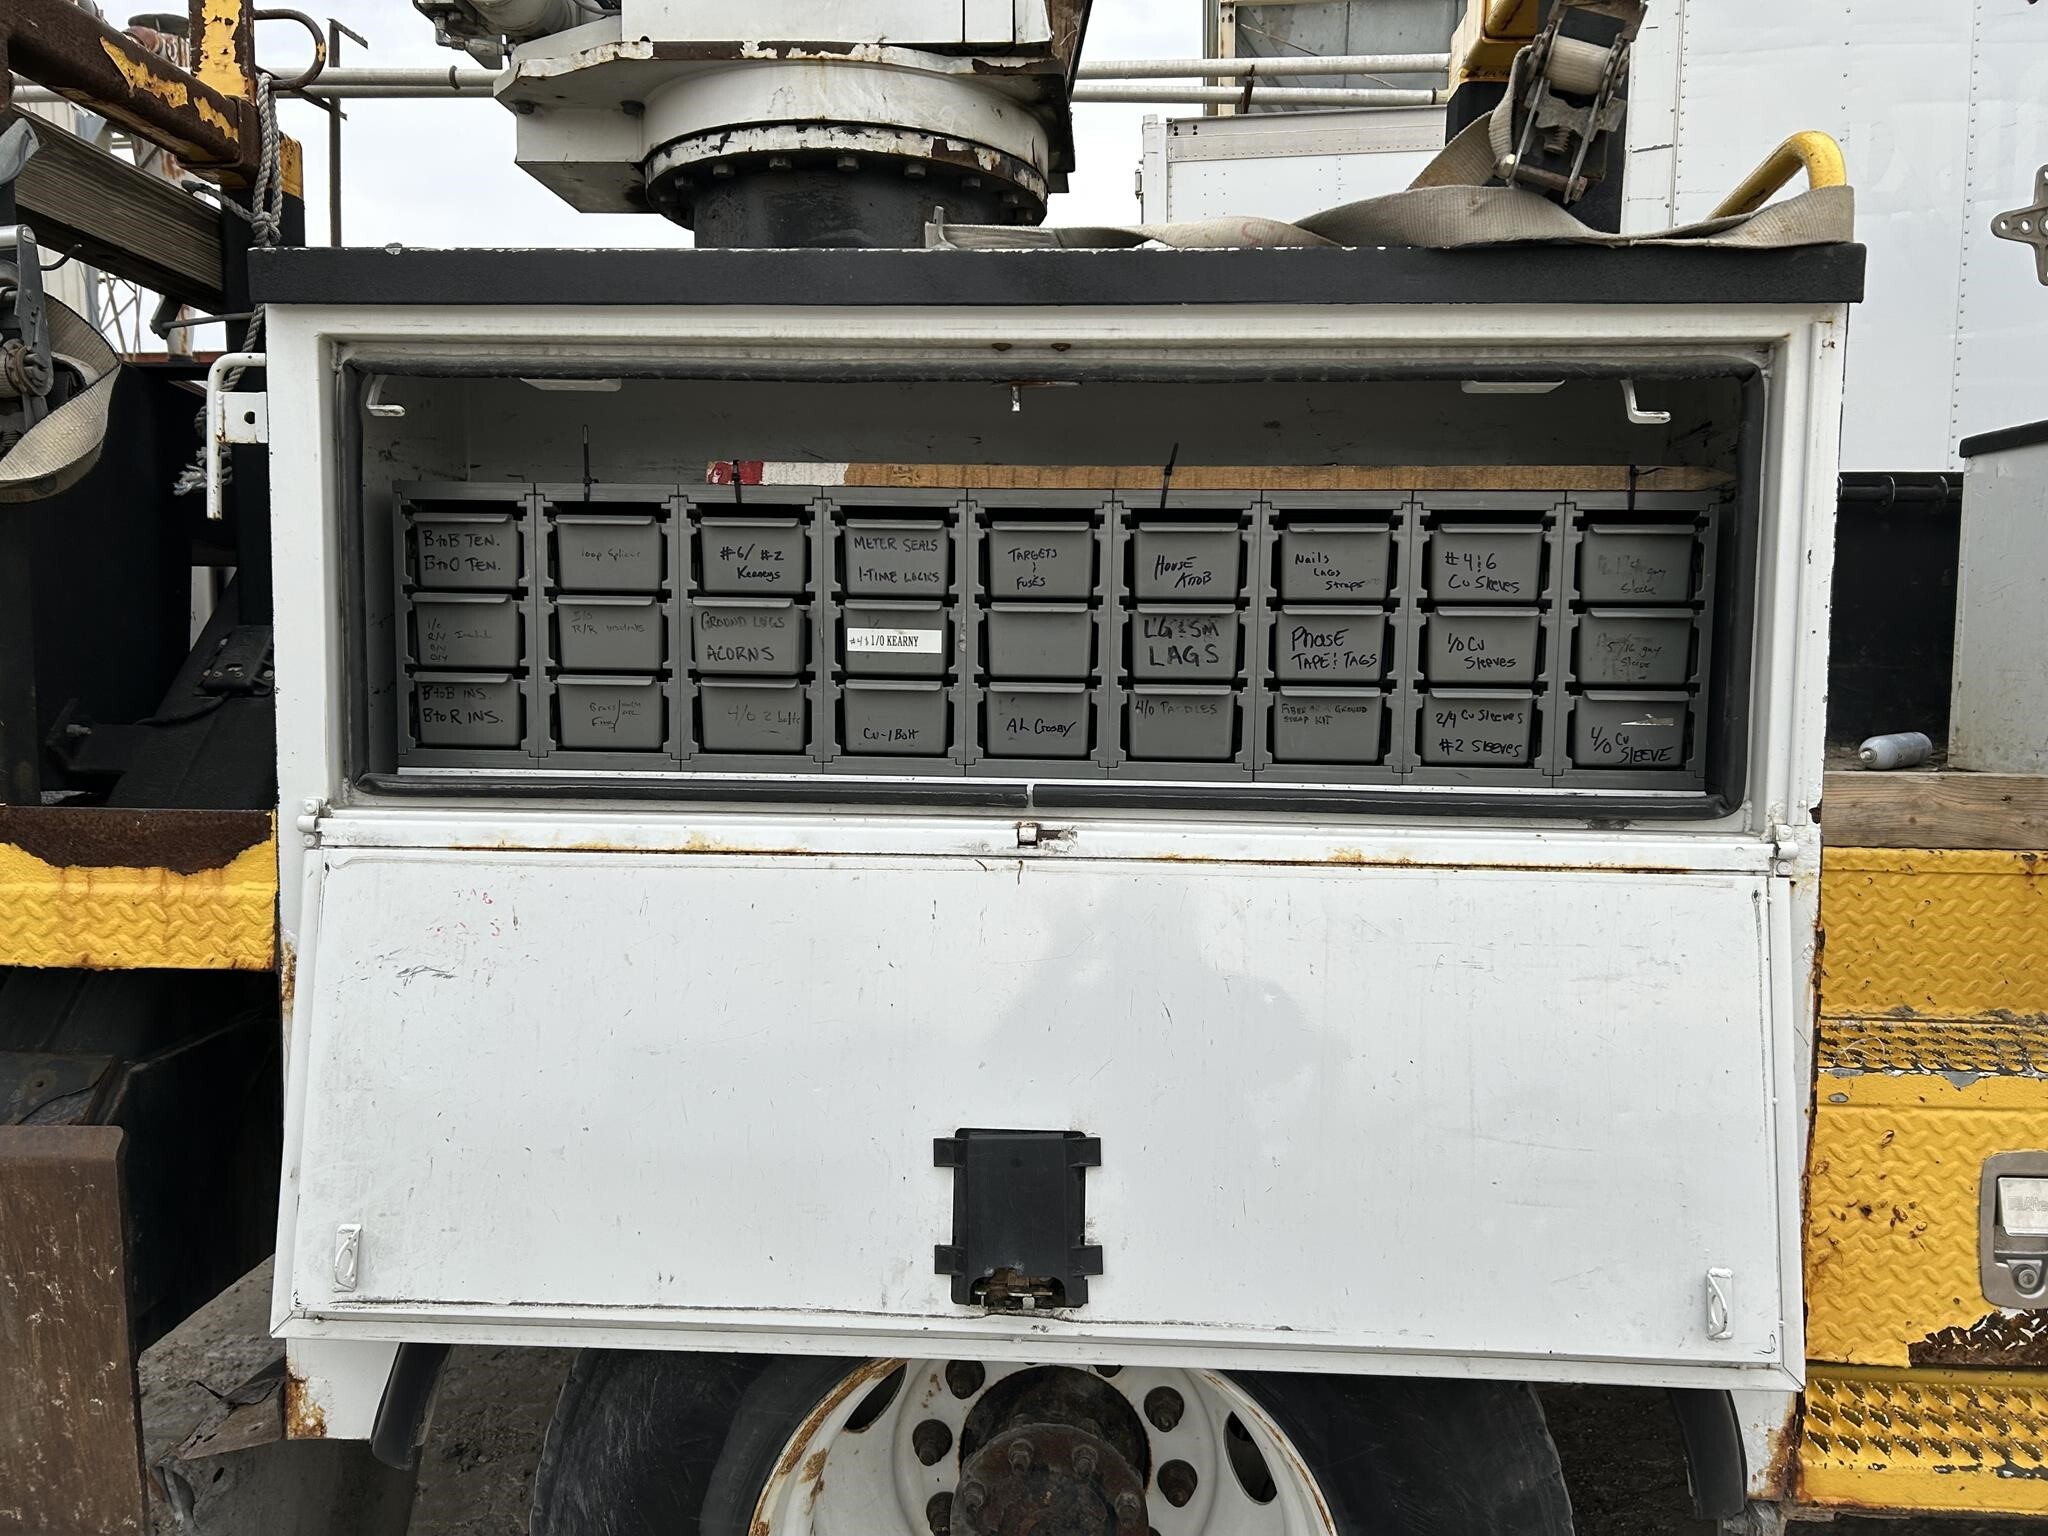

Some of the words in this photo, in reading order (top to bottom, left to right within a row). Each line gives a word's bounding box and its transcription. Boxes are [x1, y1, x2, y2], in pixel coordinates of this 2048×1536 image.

[854, 535, 897, 550] METER
[902, 538, 938, 552] SEALS
[761, 549, 785, 560] #2
[1008, 547, 1057, 562] TARGETS
[1295, 551, 1330, 565] Nails
[1485, 552, 1497, 570] 6
[859, 566, 897, 583] 1-TIME
[904, 571, 940, 583] LOCKS
[1474, 575, 1520, 594] Sleeves
[700, 610, 747, 631] GROUND
[1144, 617, 1173, 639] LG
[871, 634, 885, 647] 1/0
[886, 635, 919, 648] KEARNY
[1448, 633, 1465, 653] 1/0
[706, 644, 776, 662] ACORNS
[1148, 643, 1220, 667] LAGS
[1291, 652, 1331, 670] TAPE
[1343, 650, 1378, 669] TAGS
[1463, 655, 1517, 671] Sleeves
[467, 710, 504, 724] INS.
[1135, 699, 1155, 720] 4/0
[1478, 709, 1523, 724] Sleeves
[1315, 714, 1333, 726] KIT
[1439, 738, 1464, 756] #2
[1471, 739, 1523, 758] Sleeves
[1591, 726, 1612, 754] 4/0
